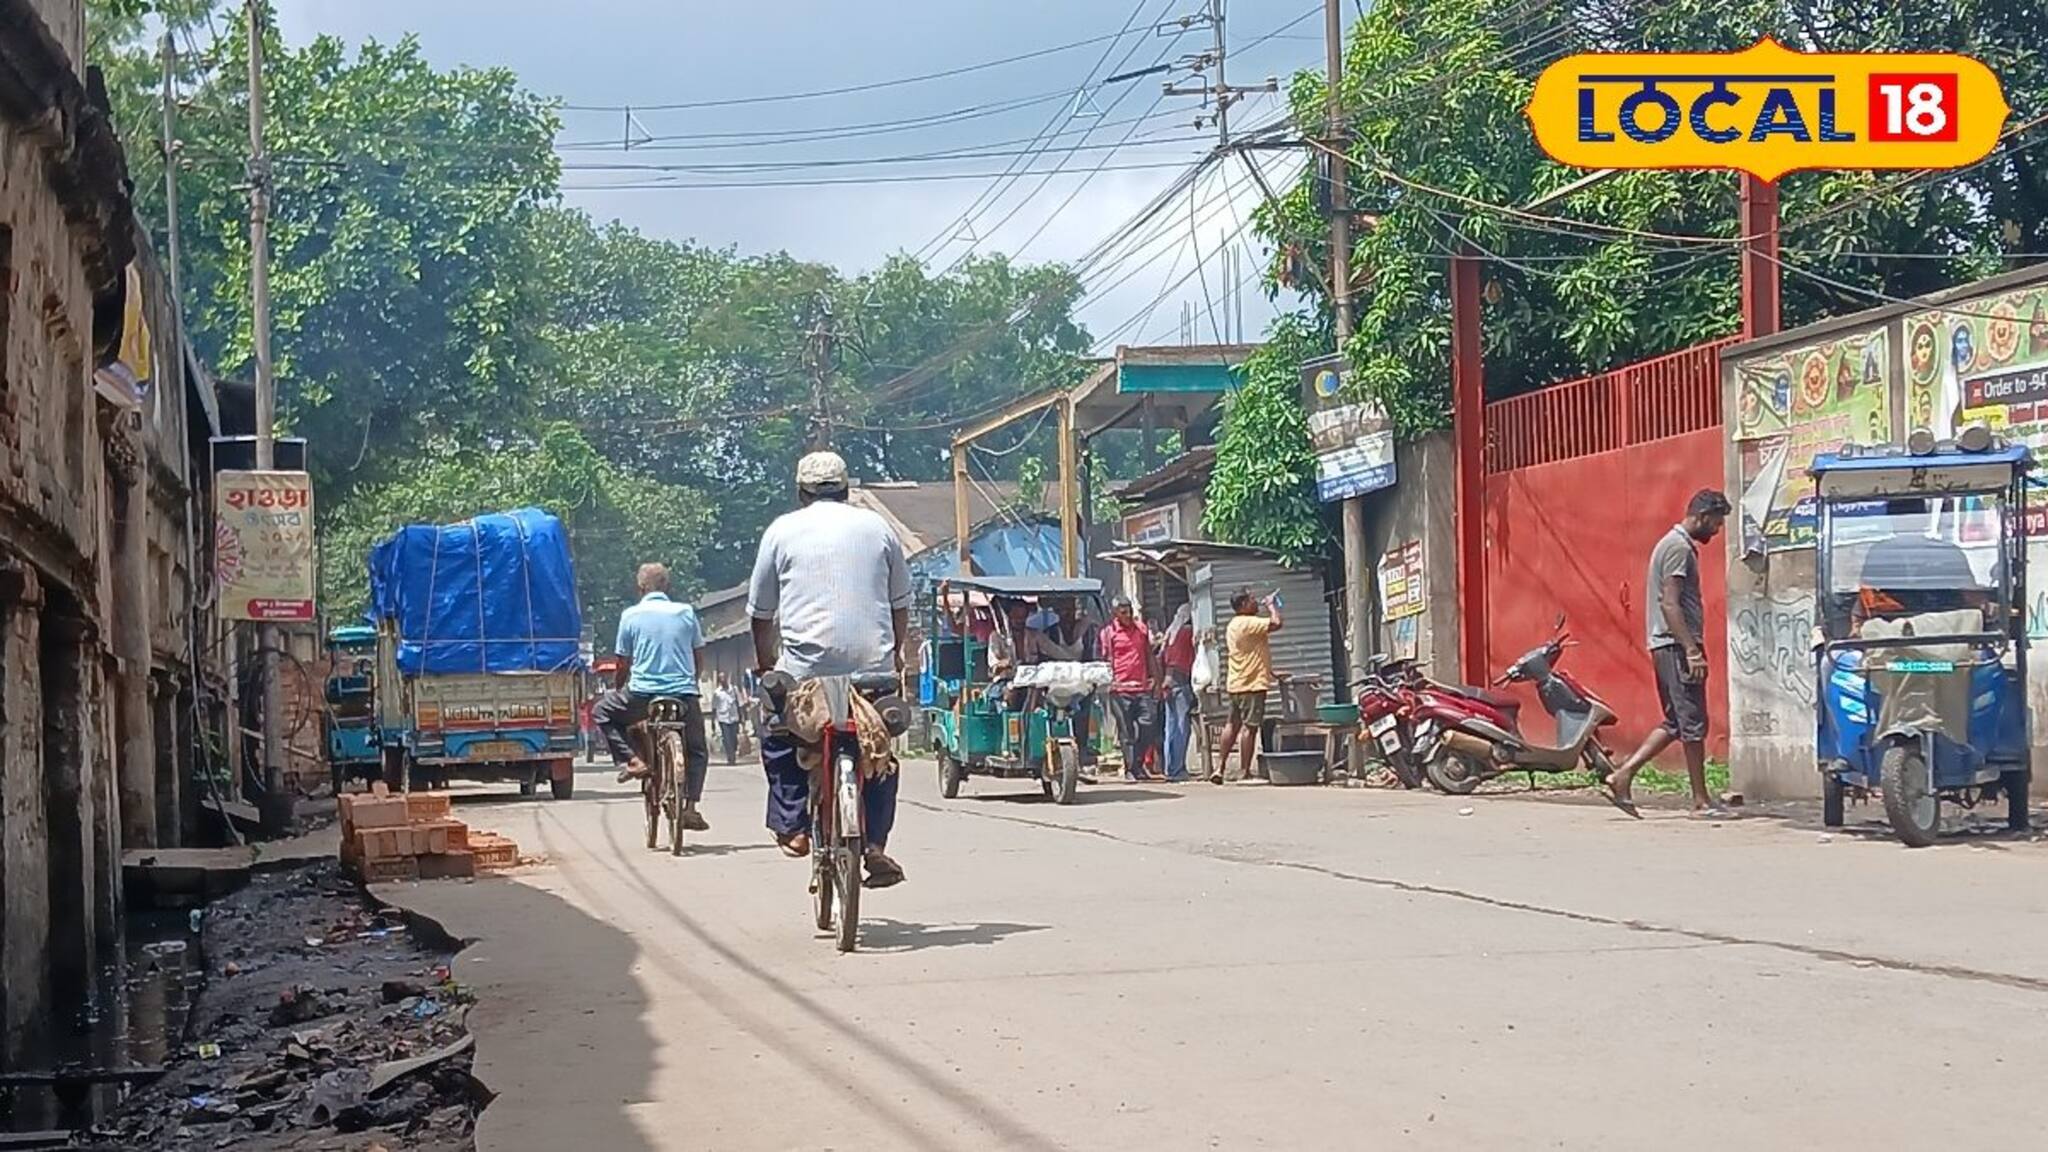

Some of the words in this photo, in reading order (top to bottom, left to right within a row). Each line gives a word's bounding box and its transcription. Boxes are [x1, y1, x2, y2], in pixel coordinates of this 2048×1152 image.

[1984, 378, 2014, 399] Order
[2015, 377, 2027, 393] to
[226, 488, 308, 511] হাওড়া
